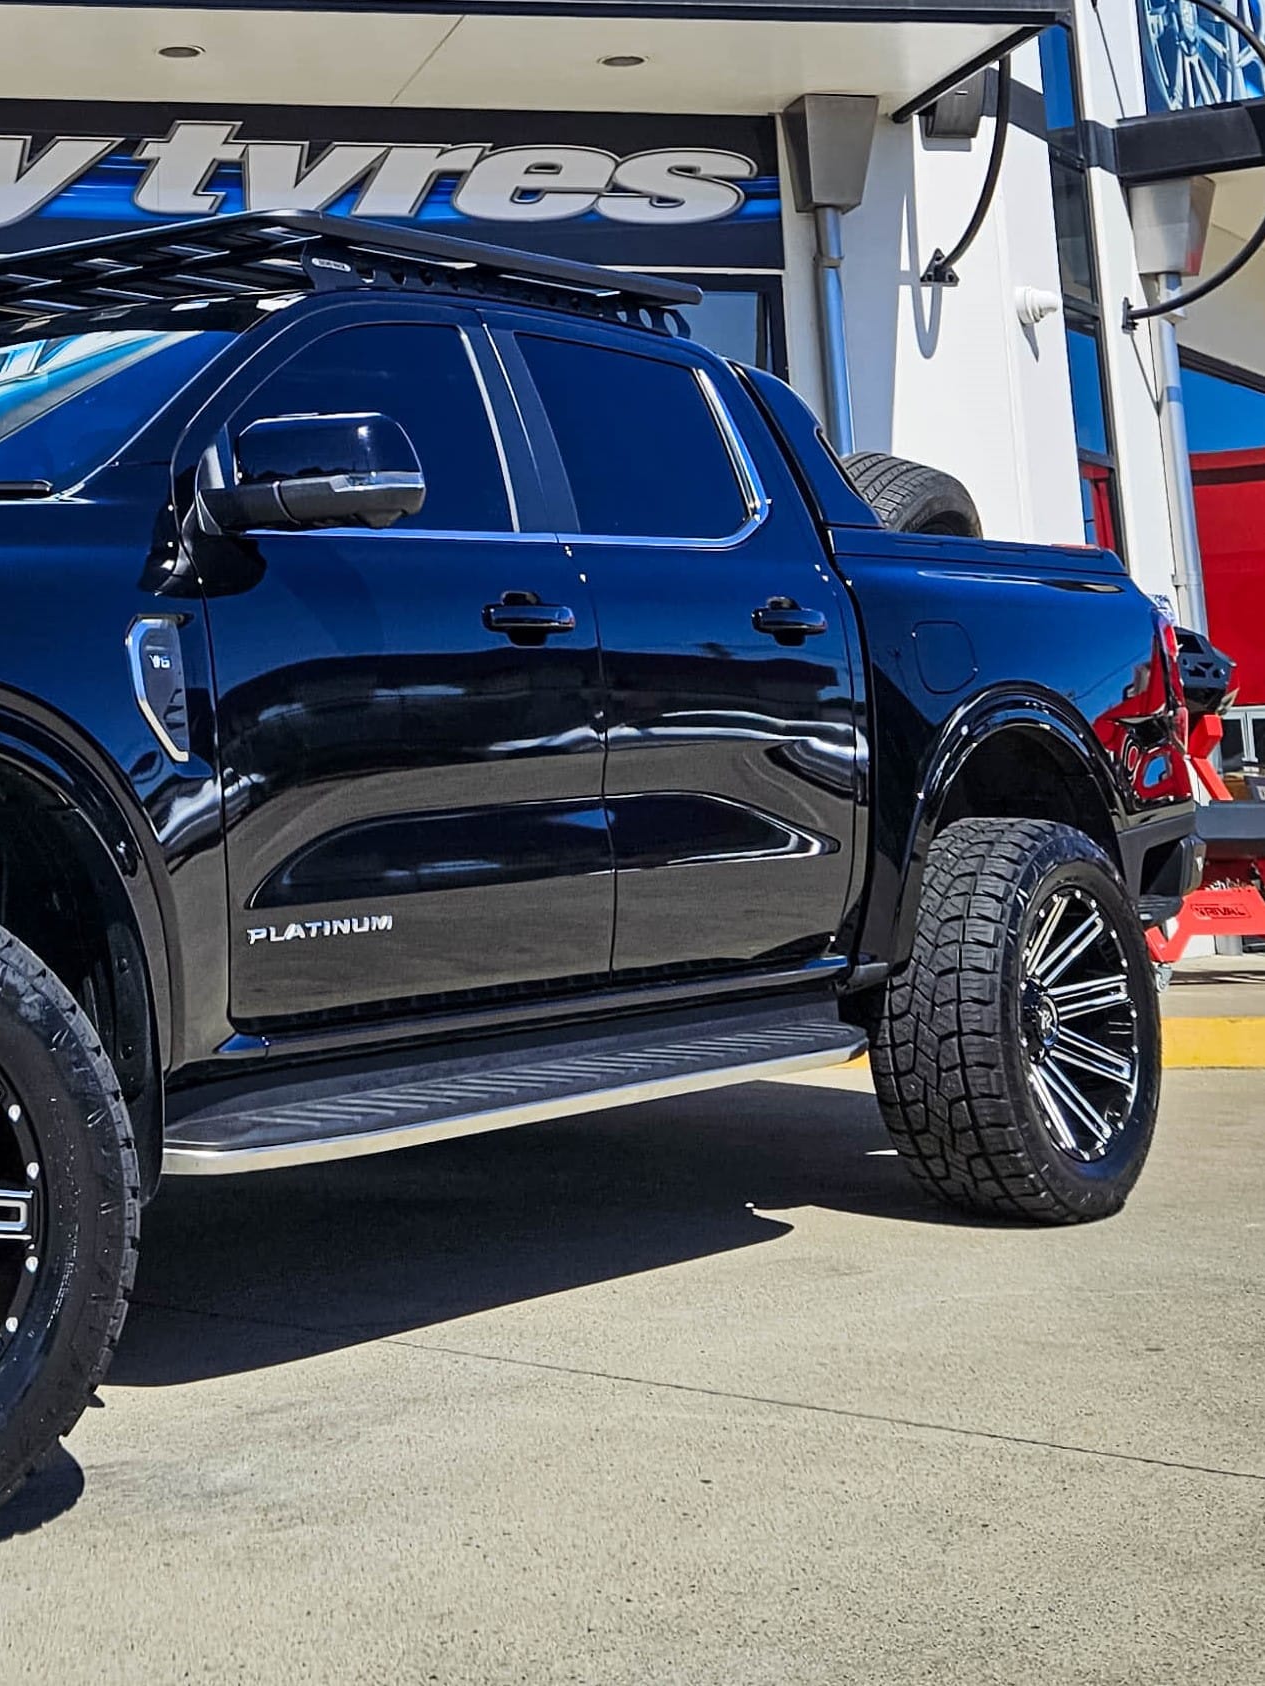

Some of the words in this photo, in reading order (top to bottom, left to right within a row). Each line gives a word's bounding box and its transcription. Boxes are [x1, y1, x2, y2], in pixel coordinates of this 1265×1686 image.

[134, 120, 757, 223] tyres
[148, 654, 171, 669] V6
[246, 914, 394, 945] PLATINUM
